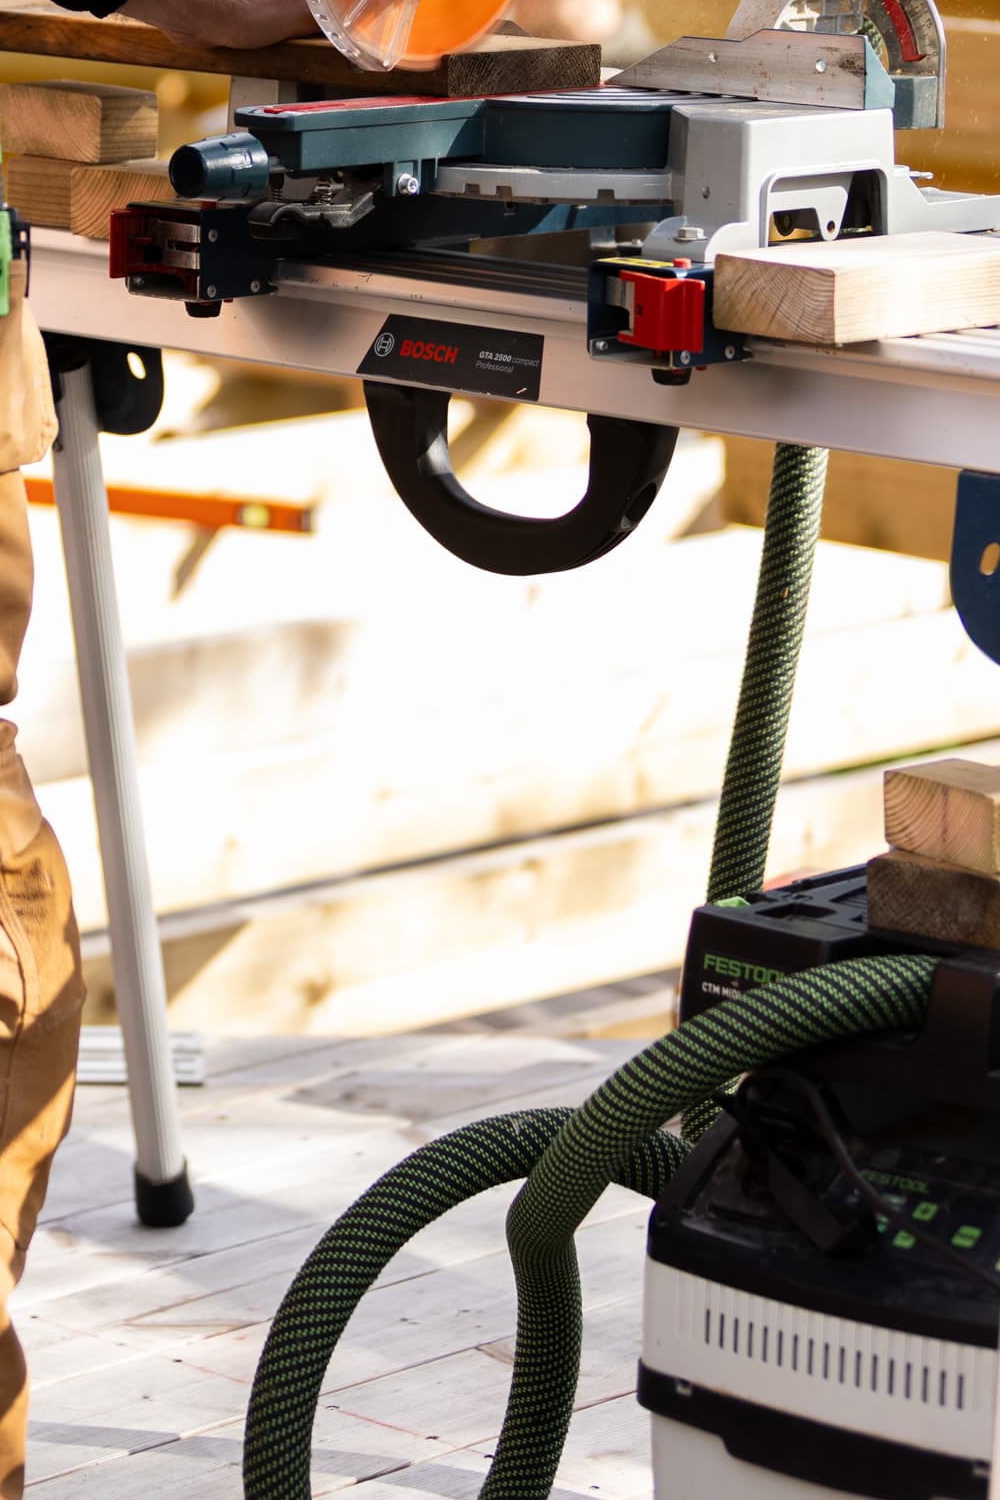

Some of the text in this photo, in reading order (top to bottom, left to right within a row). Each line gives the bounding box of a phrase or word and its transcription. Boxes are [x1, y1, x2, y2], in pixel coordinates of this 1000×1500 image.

[399, 339, 459, 365] BOSCH
[479, 350, 493, 360] GTA
[494, 353, 512, 363] 2500
[475, 360, 514, 373] Professional
[703, 953, 785, 985] FESTOO
[702, 981, 720, 995] CTM
